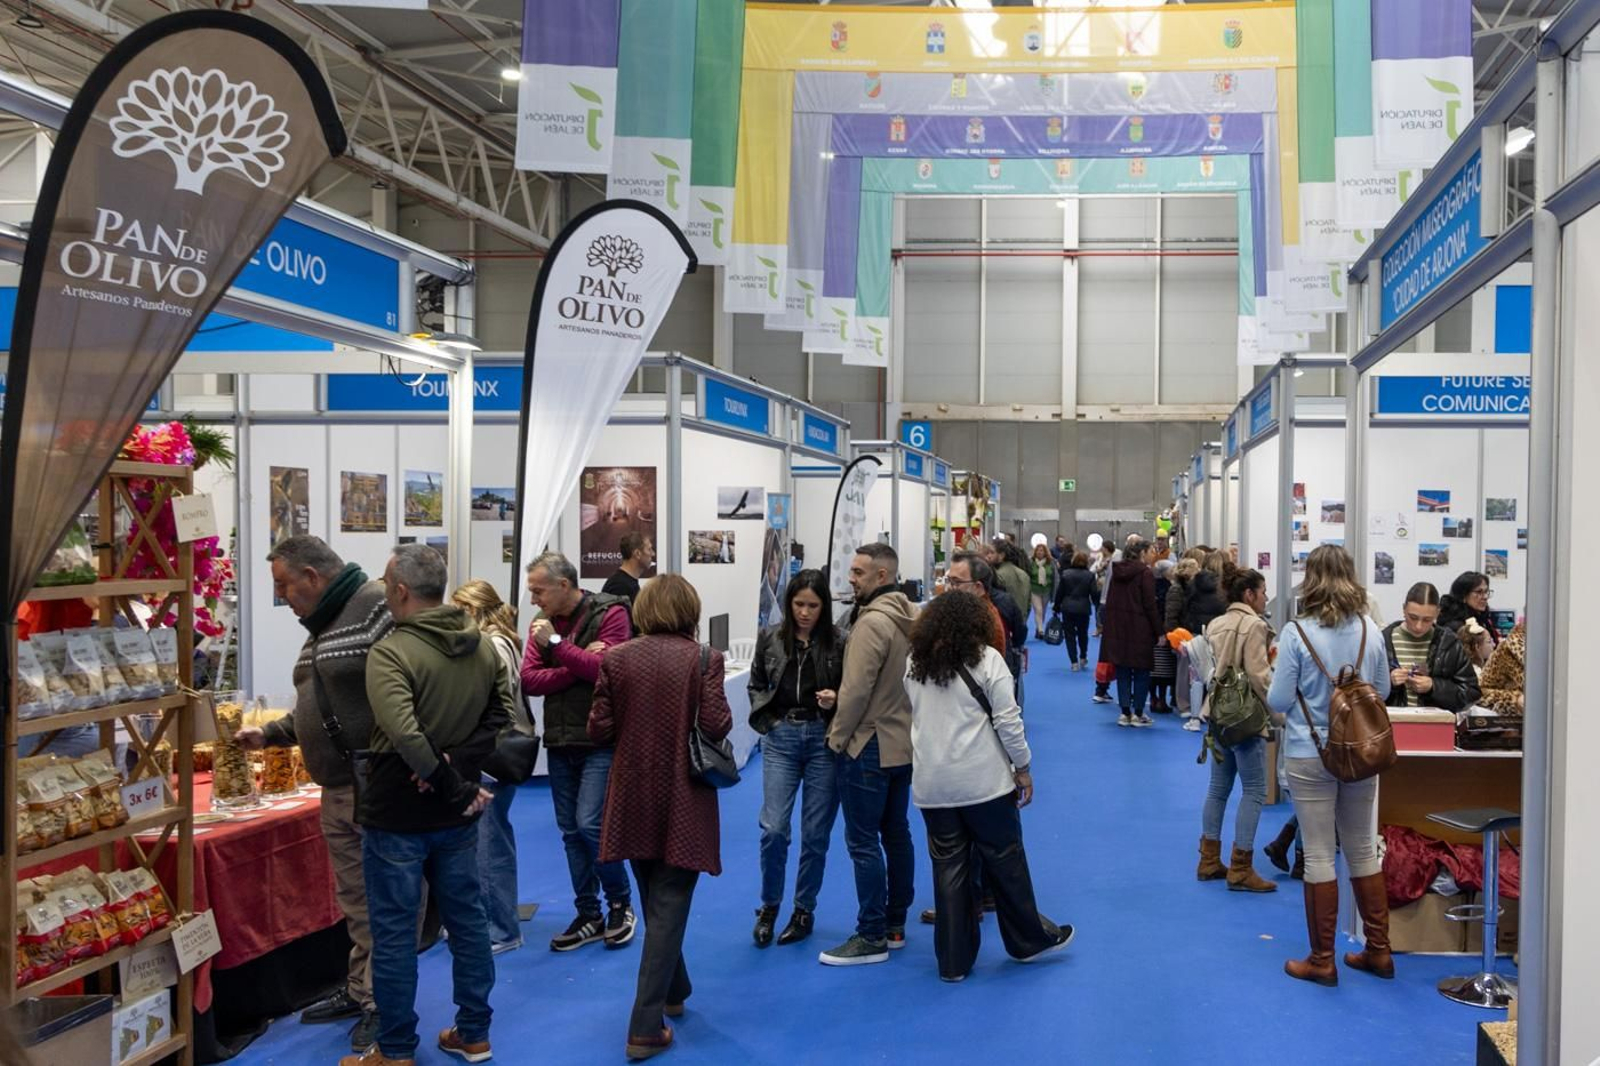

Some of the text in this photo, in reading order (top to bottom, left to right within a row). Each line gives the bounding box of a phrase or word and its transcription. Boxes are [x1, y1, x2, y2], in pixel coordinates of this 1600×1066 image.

[91, 206, 208, 265] PAN DE
[1383, 158, 1482, 288] COLECCIÓN MUSEOGRÁFIC
[60, 240, 208, 299] OLIVO
[266, 240, 327, 286] OLIVO
[61, 284, 130, 306] Artesanos
[576, 274, 643, 304] PAN DE
[557, 296, 645, 329] OLIVO
[558, 323, 643, 341] ARTESANOS PANADEROS
[1441, 376, 1531, 389] FUTURE SE
[1421, 394, 1531, 412] COMUNICA
[909, 425, 926, 448] 6
[129, 786, 158, 806] 3x 6€
